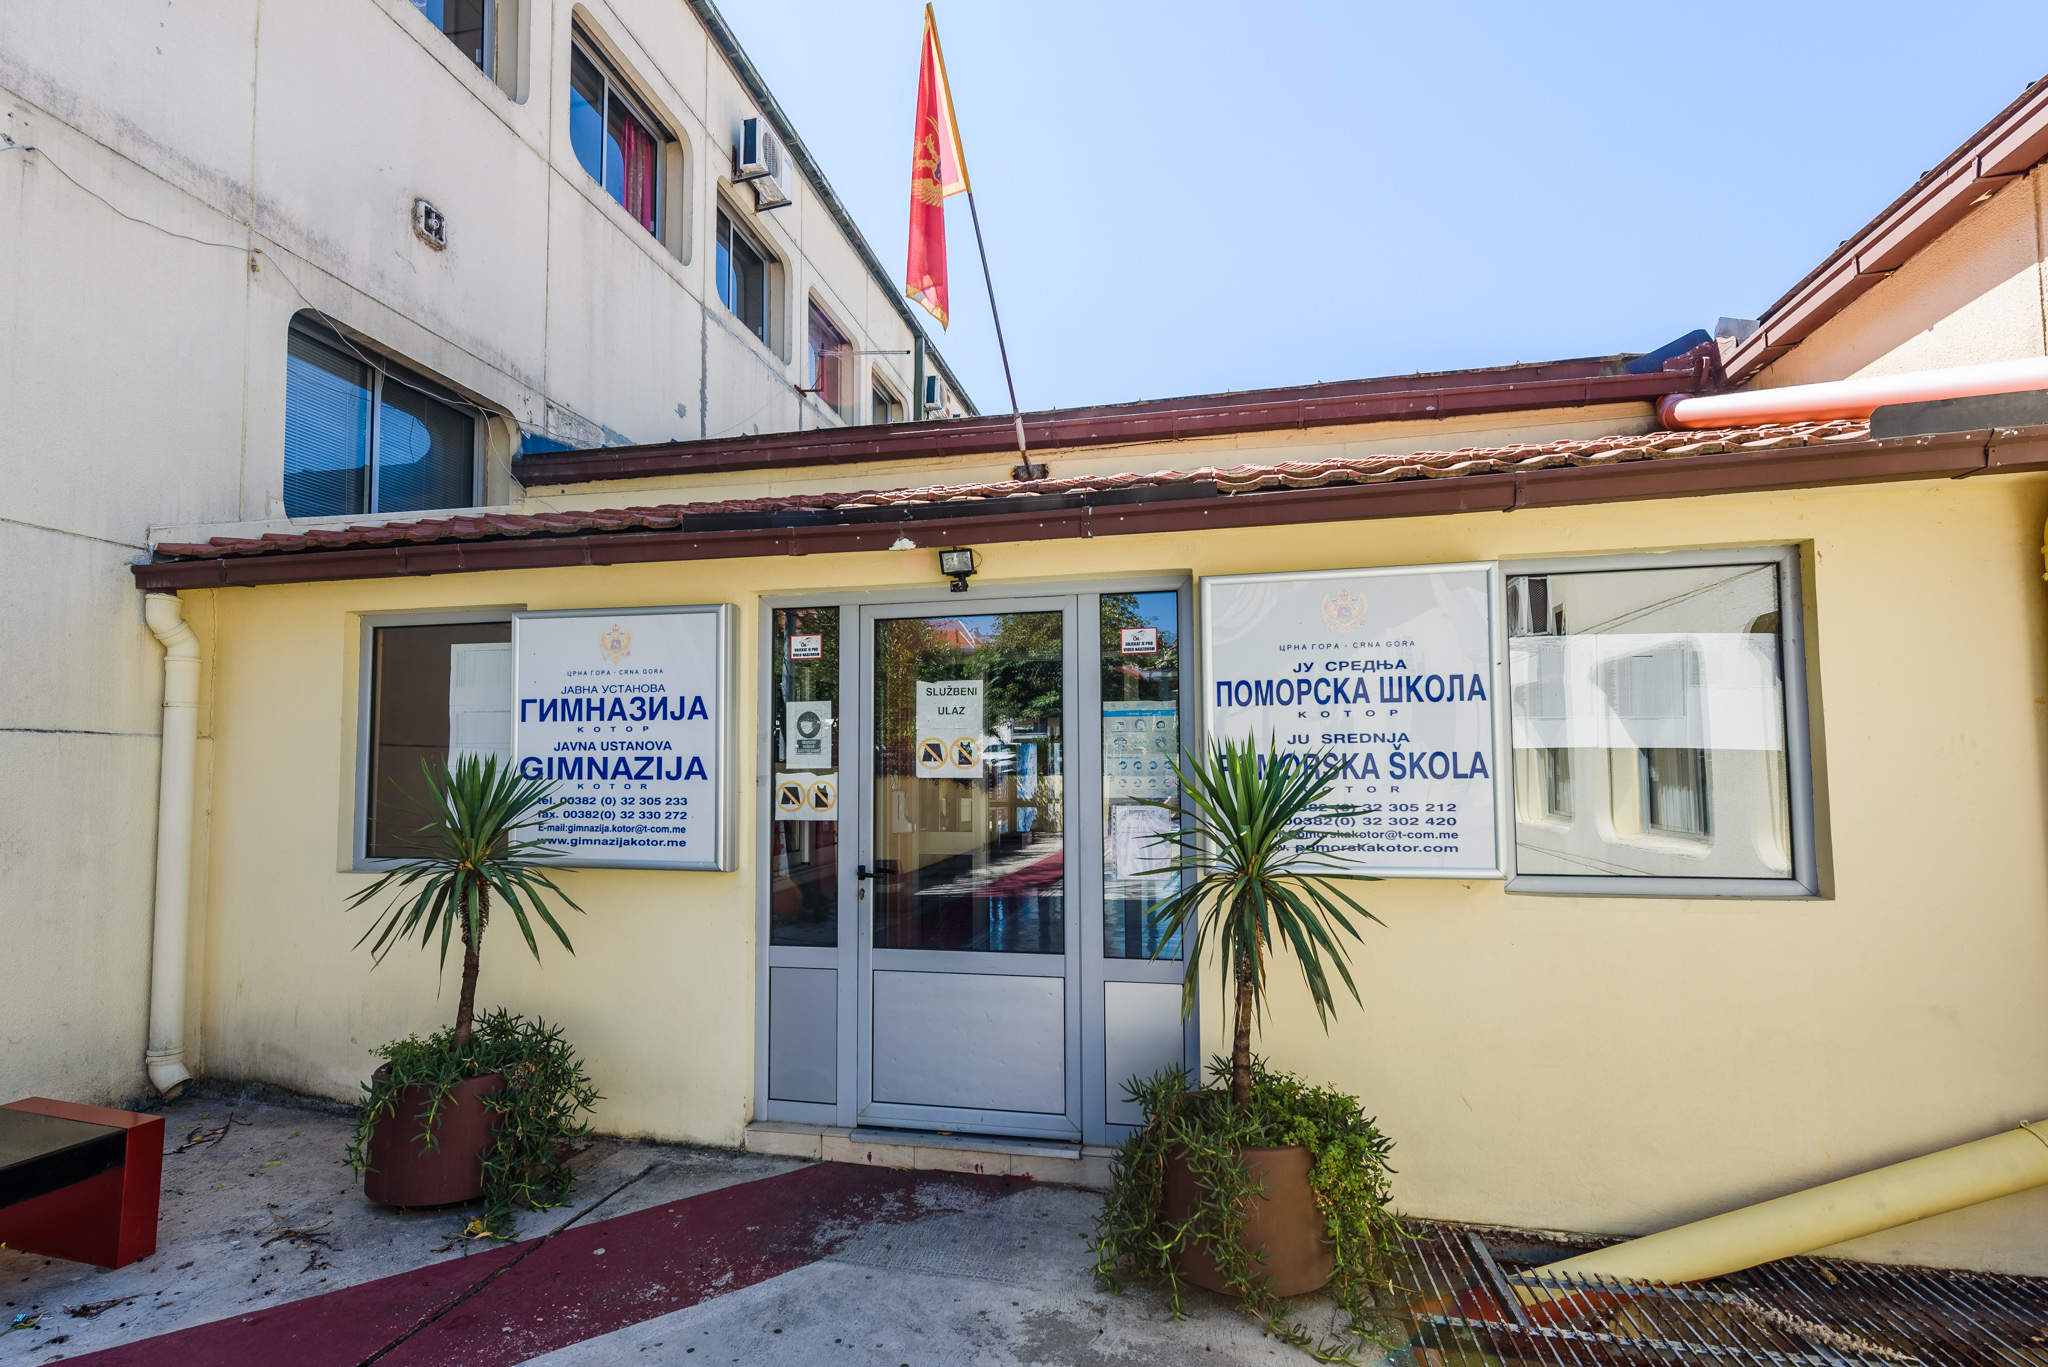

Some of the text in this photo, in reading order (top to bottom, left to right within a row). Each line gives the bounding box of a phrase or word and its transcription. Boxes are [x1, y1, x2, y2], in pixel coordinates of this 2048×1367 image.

[1279, 644, 1307, 652] ЦРНА
[1353, 641, 1380, 649] CRNA
[1386, 640, 1416, 648] GORA
[1293, 659, 1407, 673] ЈУ СРЕДЊА
[561, 684, 665, 695] ЈАВНА УСТАНОВА
[926, 685, 978, 696] SLUŽBENI
[1216, 674, 1487, 707] ПОМОРСКА ШКОЛА
[520, 696, 708, 723] ГИМНАЗИЈА
[937, 706, 965, 715] ULAZ
[1287, 732, 1410, 745] JU SREDNJA
[554, 741, 672, 751] JAVNA USTANOVA
[1389, 743, 1489, 780] ŠKOLA
[520, 756, 708, 780] GIMNAZIJA
[560, 797, 596, 806] 00382
[600, 797, 617, 807] (0)
[620, 797, 635, 806] 32
[639, 797, 661, 806] 305
[665, 797, 688, 806] 233
[1362, 803, 1383, 812] 32
[1388, 803, 1419, 812] 305
[1425, 803, 1457, 812] 212
[620, 811, 635, 819] 32
[639, 811, 661, 819] 330
[665, 811, 688, 820] 272
[1362, 817, 1383, 826] 32
[1388, 817, 1419, 826] 302
[1425, 817, 1457, 826] 420
[1295, 843, 1459, 854] pomorskakotor.com
